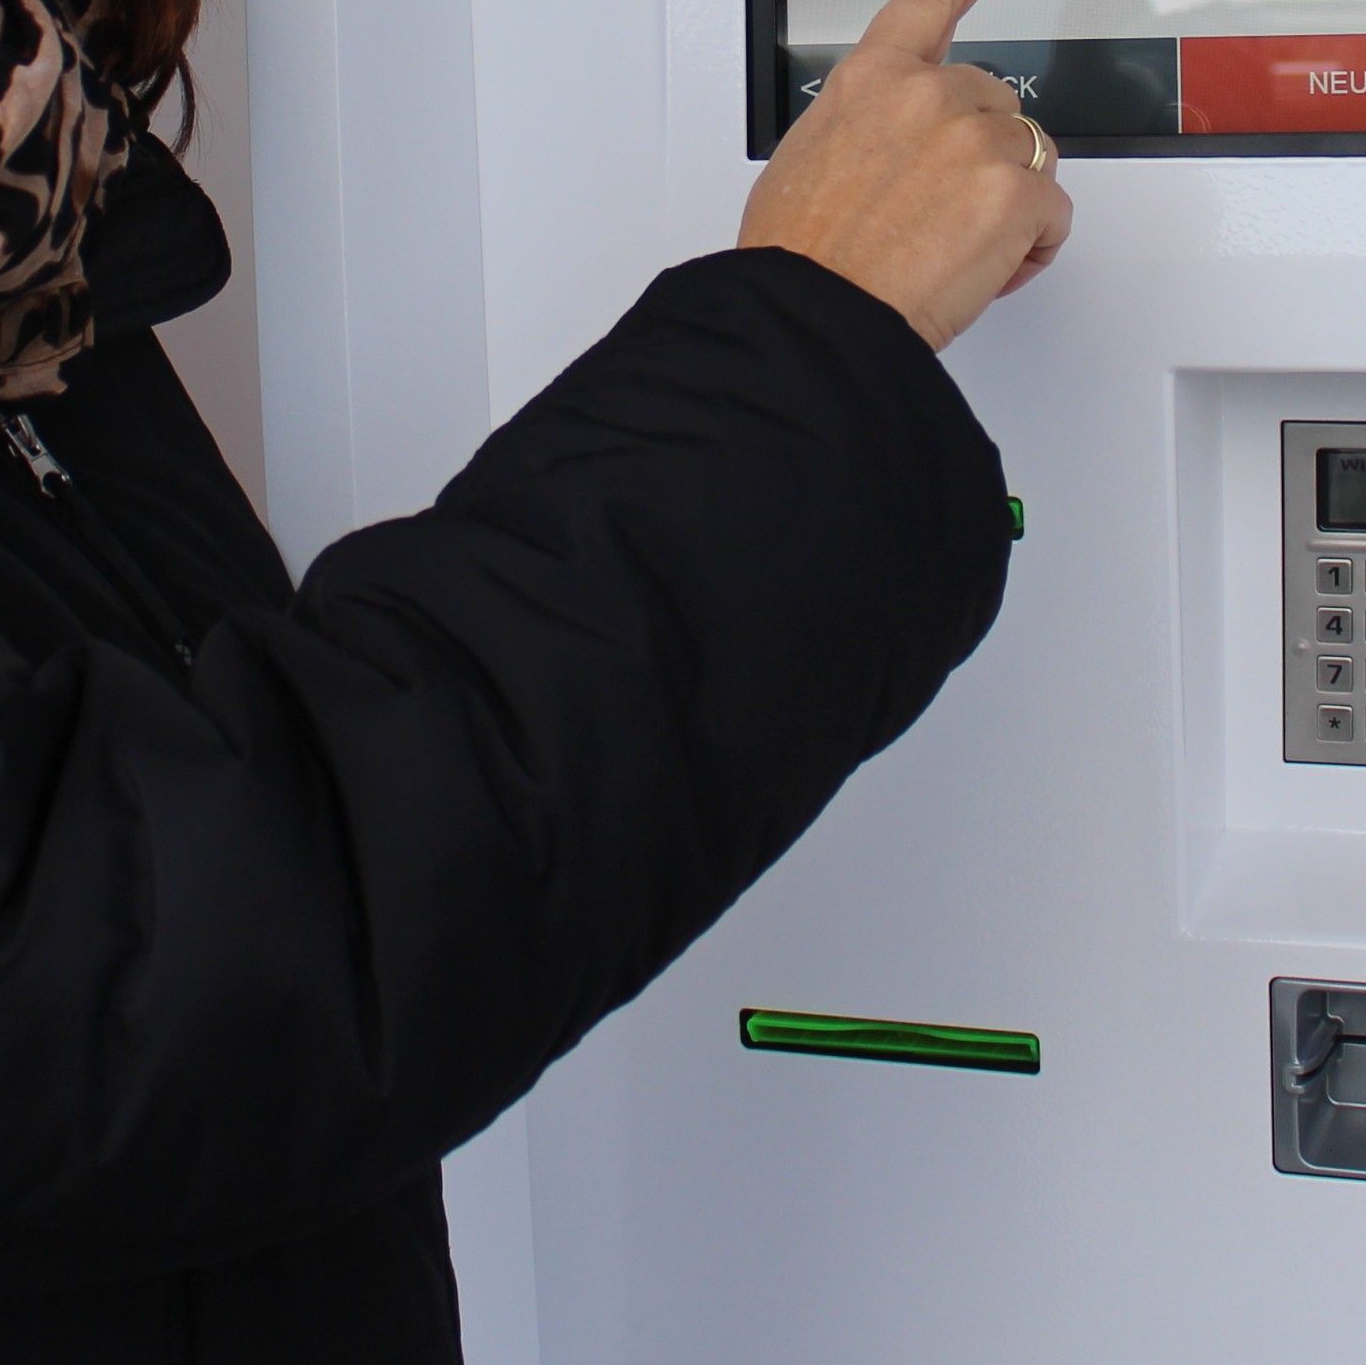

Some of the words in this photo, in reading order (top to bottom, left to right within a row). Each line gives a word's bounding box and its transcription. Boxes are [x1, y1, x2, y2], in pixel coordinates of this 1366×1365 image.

[1327, 566, 1341, 587] 1
[1325, 615, 1343, 635] 4
[1326, 663, 1343, 684] 7
